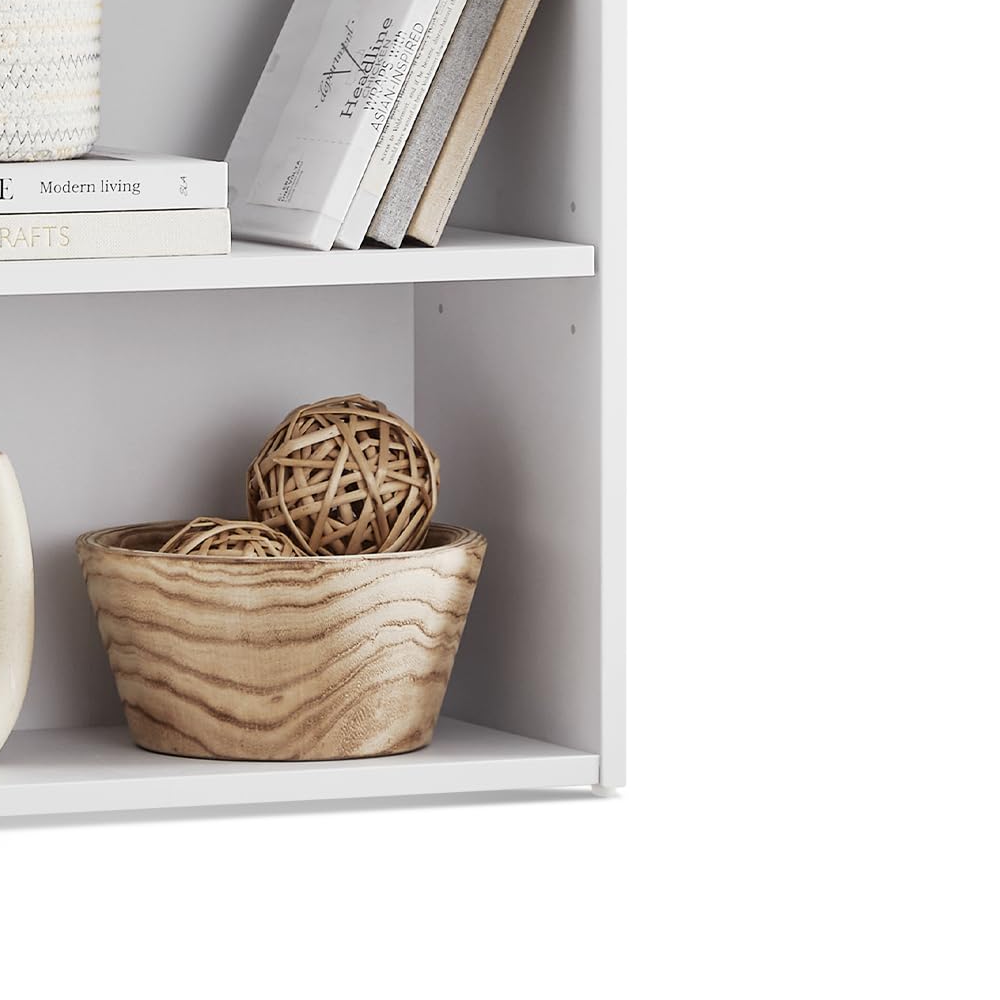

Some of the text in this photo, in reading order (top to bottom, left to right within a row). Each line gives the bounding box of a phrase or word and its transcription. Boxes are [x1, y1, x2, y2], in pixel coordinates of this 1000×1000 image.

[339, 18, 393, 118] Headline
[370, 22, 424, 132] ASIAN-INSPIRED
[39, 178, 141, 196] Modern living
